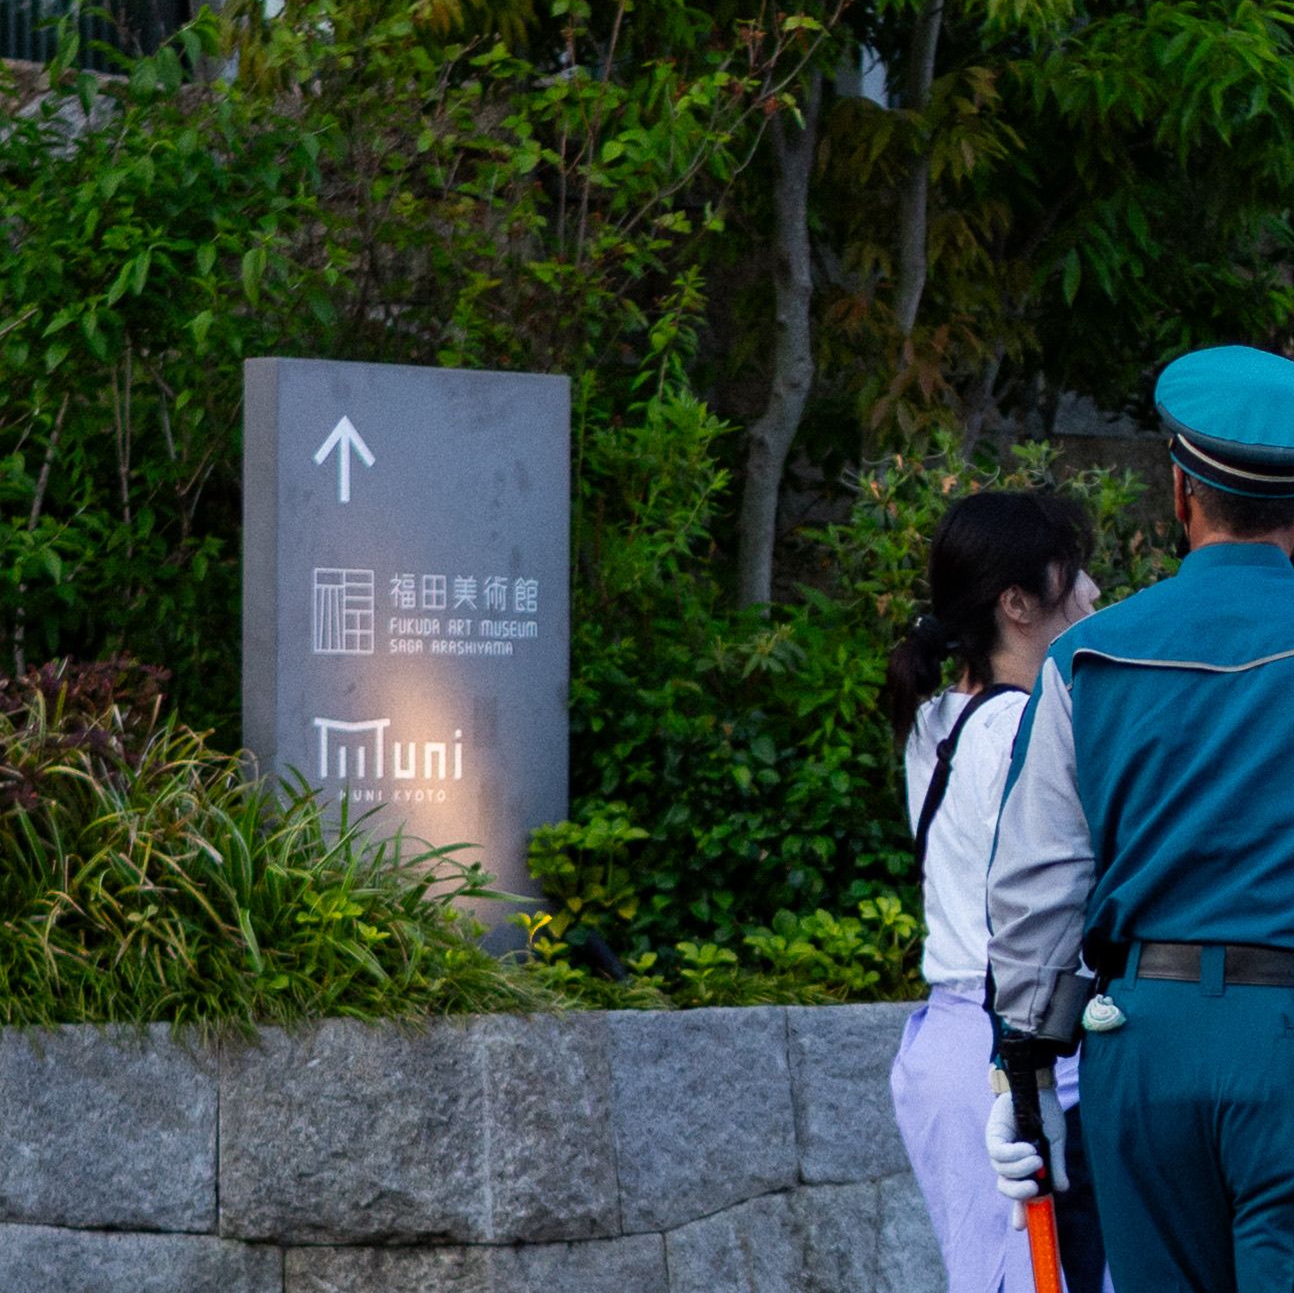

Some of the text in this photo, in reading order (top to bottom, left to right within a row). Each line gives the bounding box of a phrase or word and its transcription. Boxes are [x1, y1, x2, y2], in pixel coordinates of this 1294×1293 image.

[390, 573, 539, 613] 福田美術館
[390, 617, 440, 636] FUKUDA
[448, 619, 473, 636] ART
[389, 638, 513, 655] SAGA ARASHIYAMA
[394, 789, 447, 802] KYOTO
